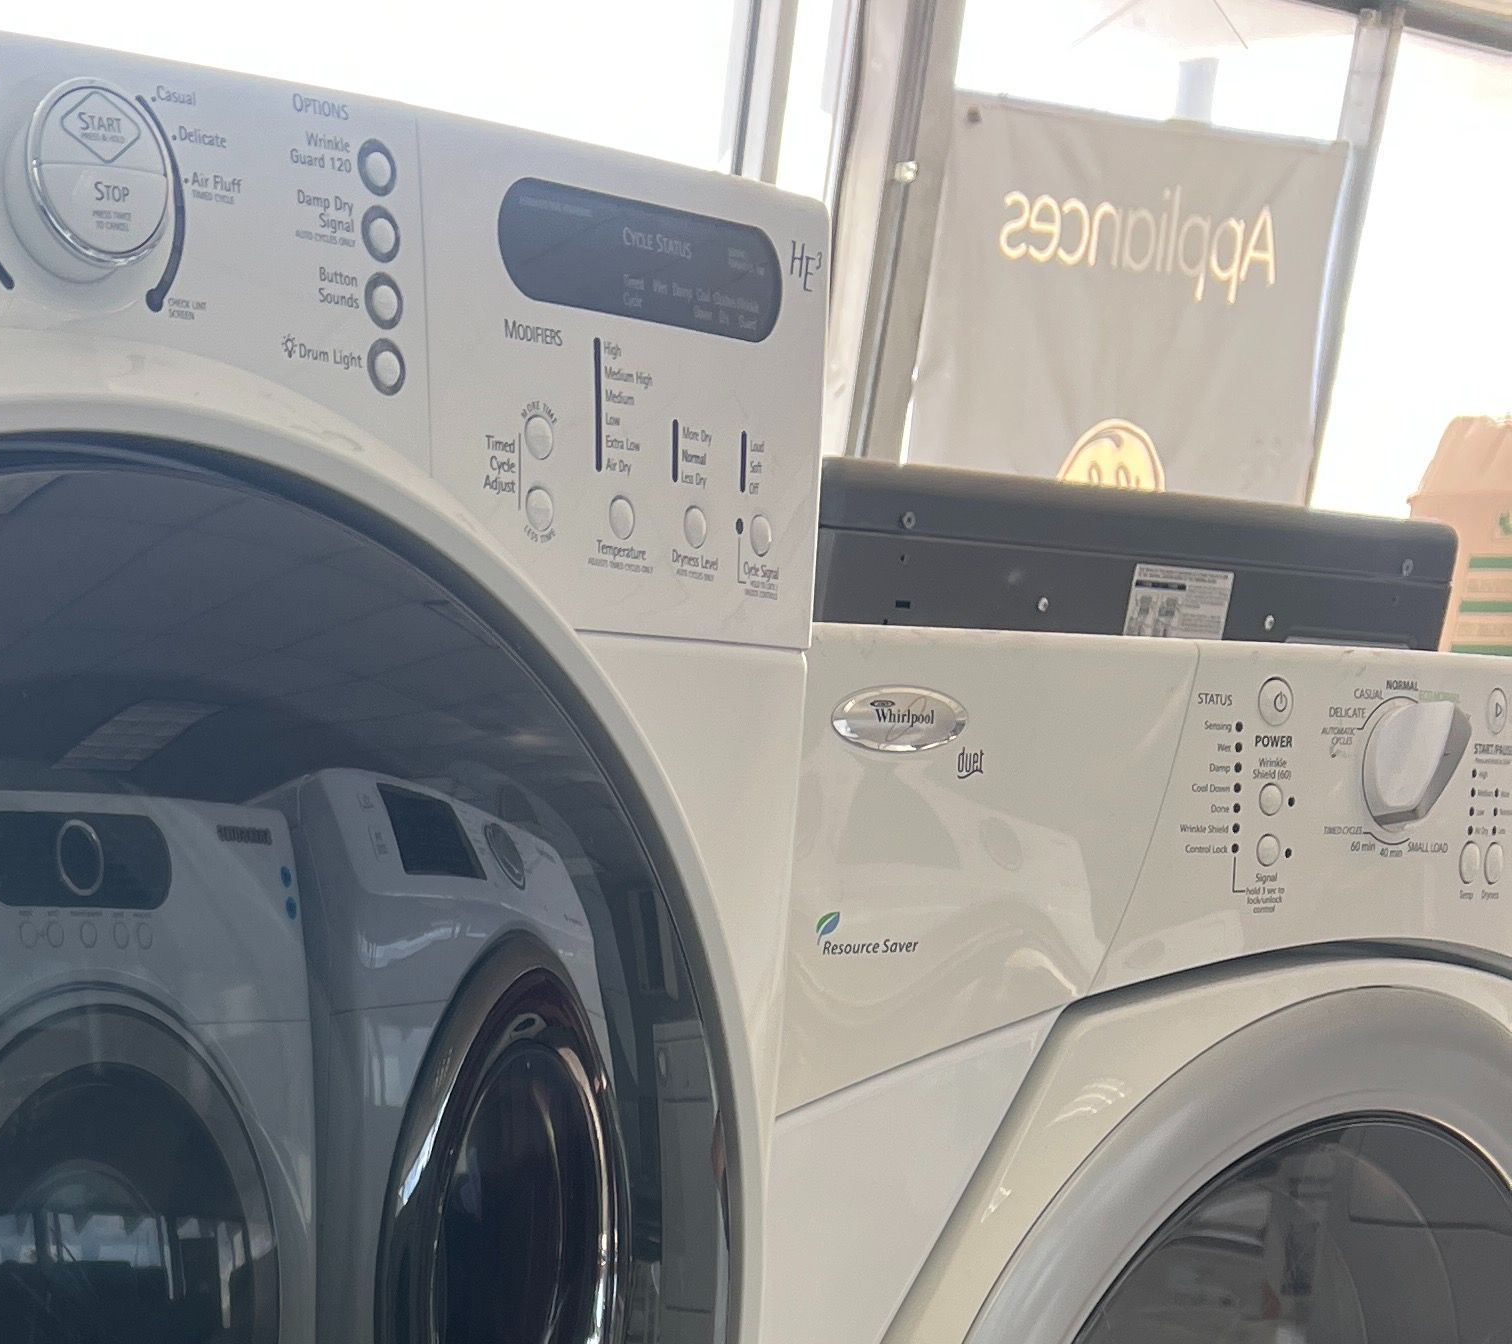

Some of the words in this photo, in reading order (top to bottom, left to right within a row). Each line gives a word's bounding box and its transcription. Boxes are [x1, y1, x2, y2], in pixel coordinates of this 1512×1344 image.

[157, 85, 196, 105] Casual
[292, 93, 349, 120] OPTIONS
[78, 112, 122, 133] START
[179, 126, 227, 149] Delicate
[306, 132, 350, 152] Wrinkle
[290, 148, 325, 168] Guard
[330, 157, 351, 173] 120
[94, 181, 130, 202] STOP
[192, 172, 209, 187] Air
[213, 175, 242, 194] Fluff
[297, 189, 330, 211] Damp
[334, 197, 353, 216] Dry
[318, 213, 354, 234] Signal
[319, 267, 358, 287] Button
[318, 288, 359, 309] Sounds
[504, 319, 562, 346] MODIFIERS
[298, 344, 328, 362] Drum
[333, 350, 362, 369] Light
[603, 341, 622, 360] High
[605, 366, 634, 384] Medium
[636, 371, 653, 389] High
[485, 435, 515, 452] Timed
[490, 456, 516, 474] Cycle
[483, 475, 516, 495] Adjust
[596, 540, 646, 561] Temperature
[672, 549, 699, 568] Dryness
[701, 555, 718, 571] Level
[1198, 693, 1232, 706] STATUS
[1354, 689, 1383, 699] CASUAL
[875, 709, 934, 727] Whirlpool
[1329, 707, 1366, 718] DELICATE
[1204, 721, 1232, 732] Sensing
[1255, 735, 1292, 748] POWER
[957, 747, 984, 774] duet
[1258, 757, 1286, 768] Wrinkle
[1253, 768, 1276, 780] Shield
[1277, 769, 1292, 779] (60)
[1211, 804, 1229, 813] Done
[1255, 873, 1278, 883] Signal
[823, 941, 879, 955] Resource
[882, 939, 918, 953] Saver
